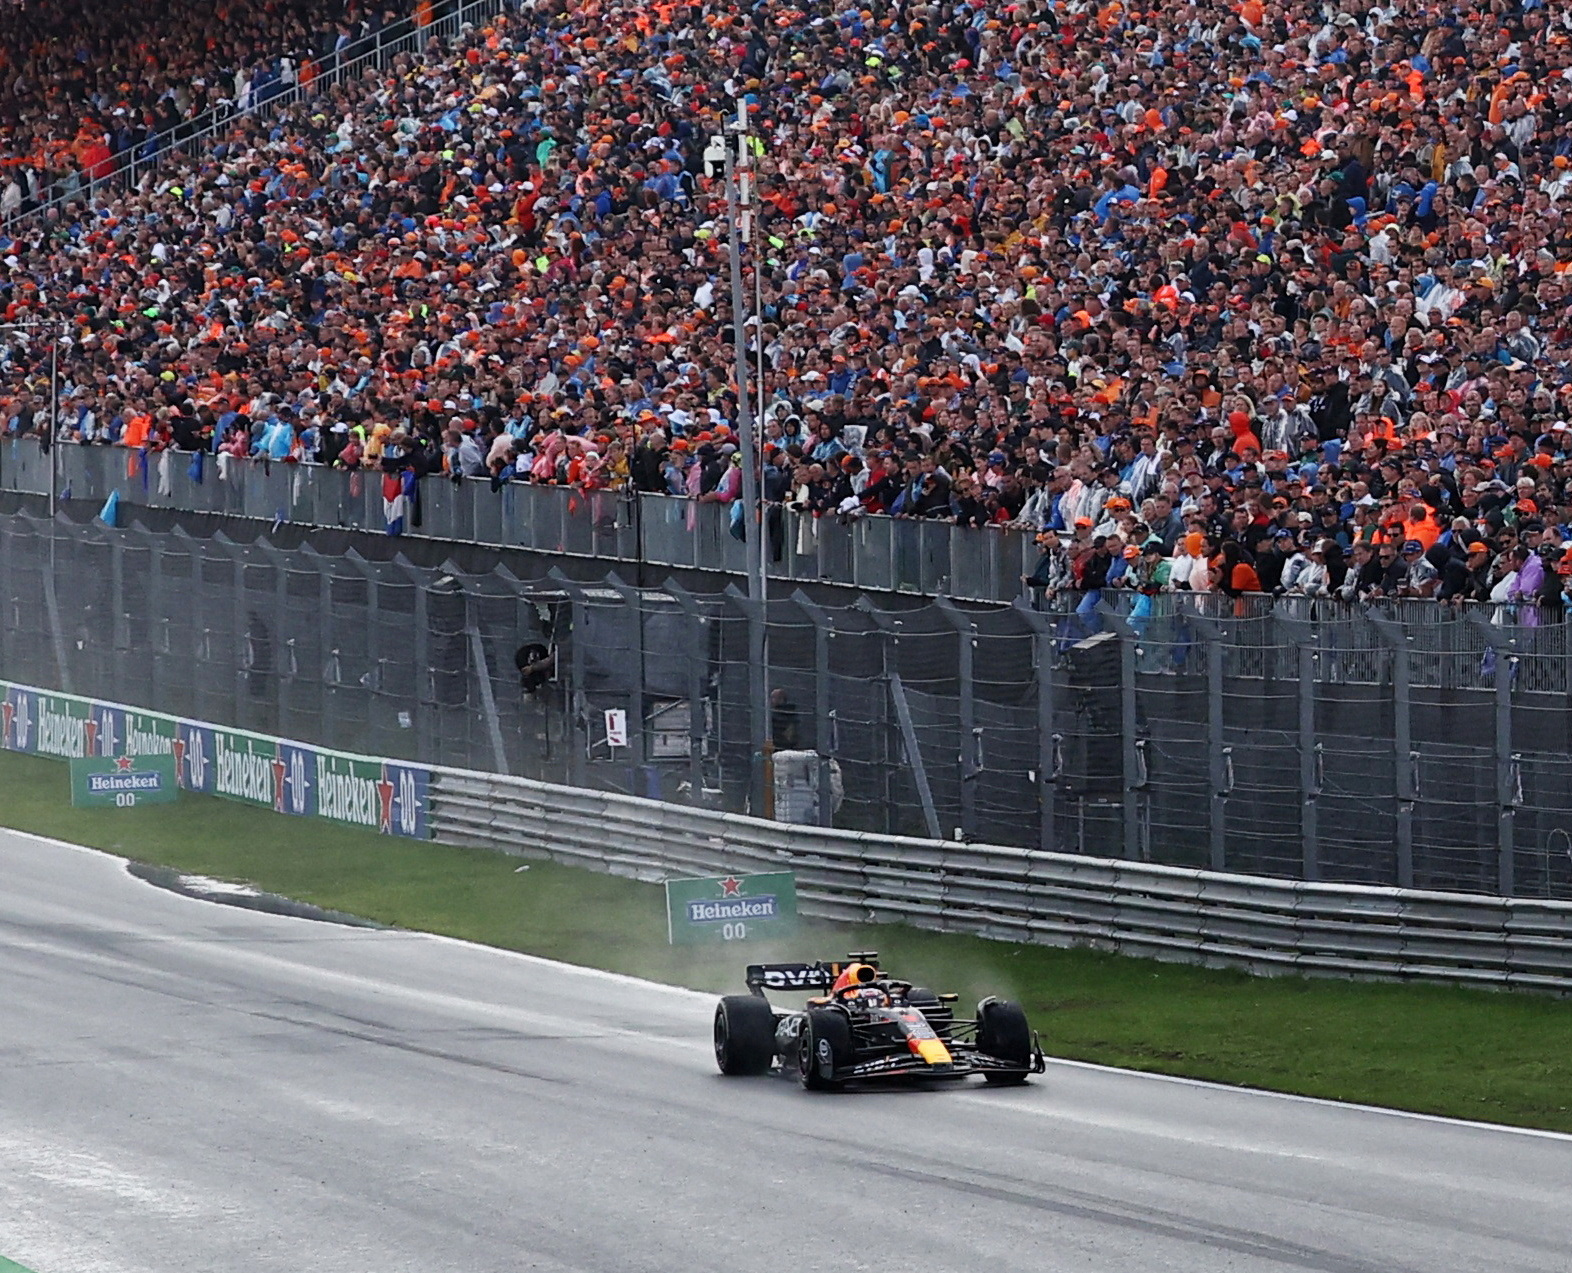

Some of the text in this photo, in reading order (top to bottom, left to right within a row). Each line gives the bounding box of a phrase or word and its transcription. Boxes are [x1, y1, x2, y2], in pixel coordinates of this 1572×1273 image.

[37, 697, 84, 758] Heineken
[91, 775, 158, 790] Heineken
[214, 732, 272, 802] Heineken
[316, 755, 377, 826] Heineken
[691, 901, 773, 920] Heineken
